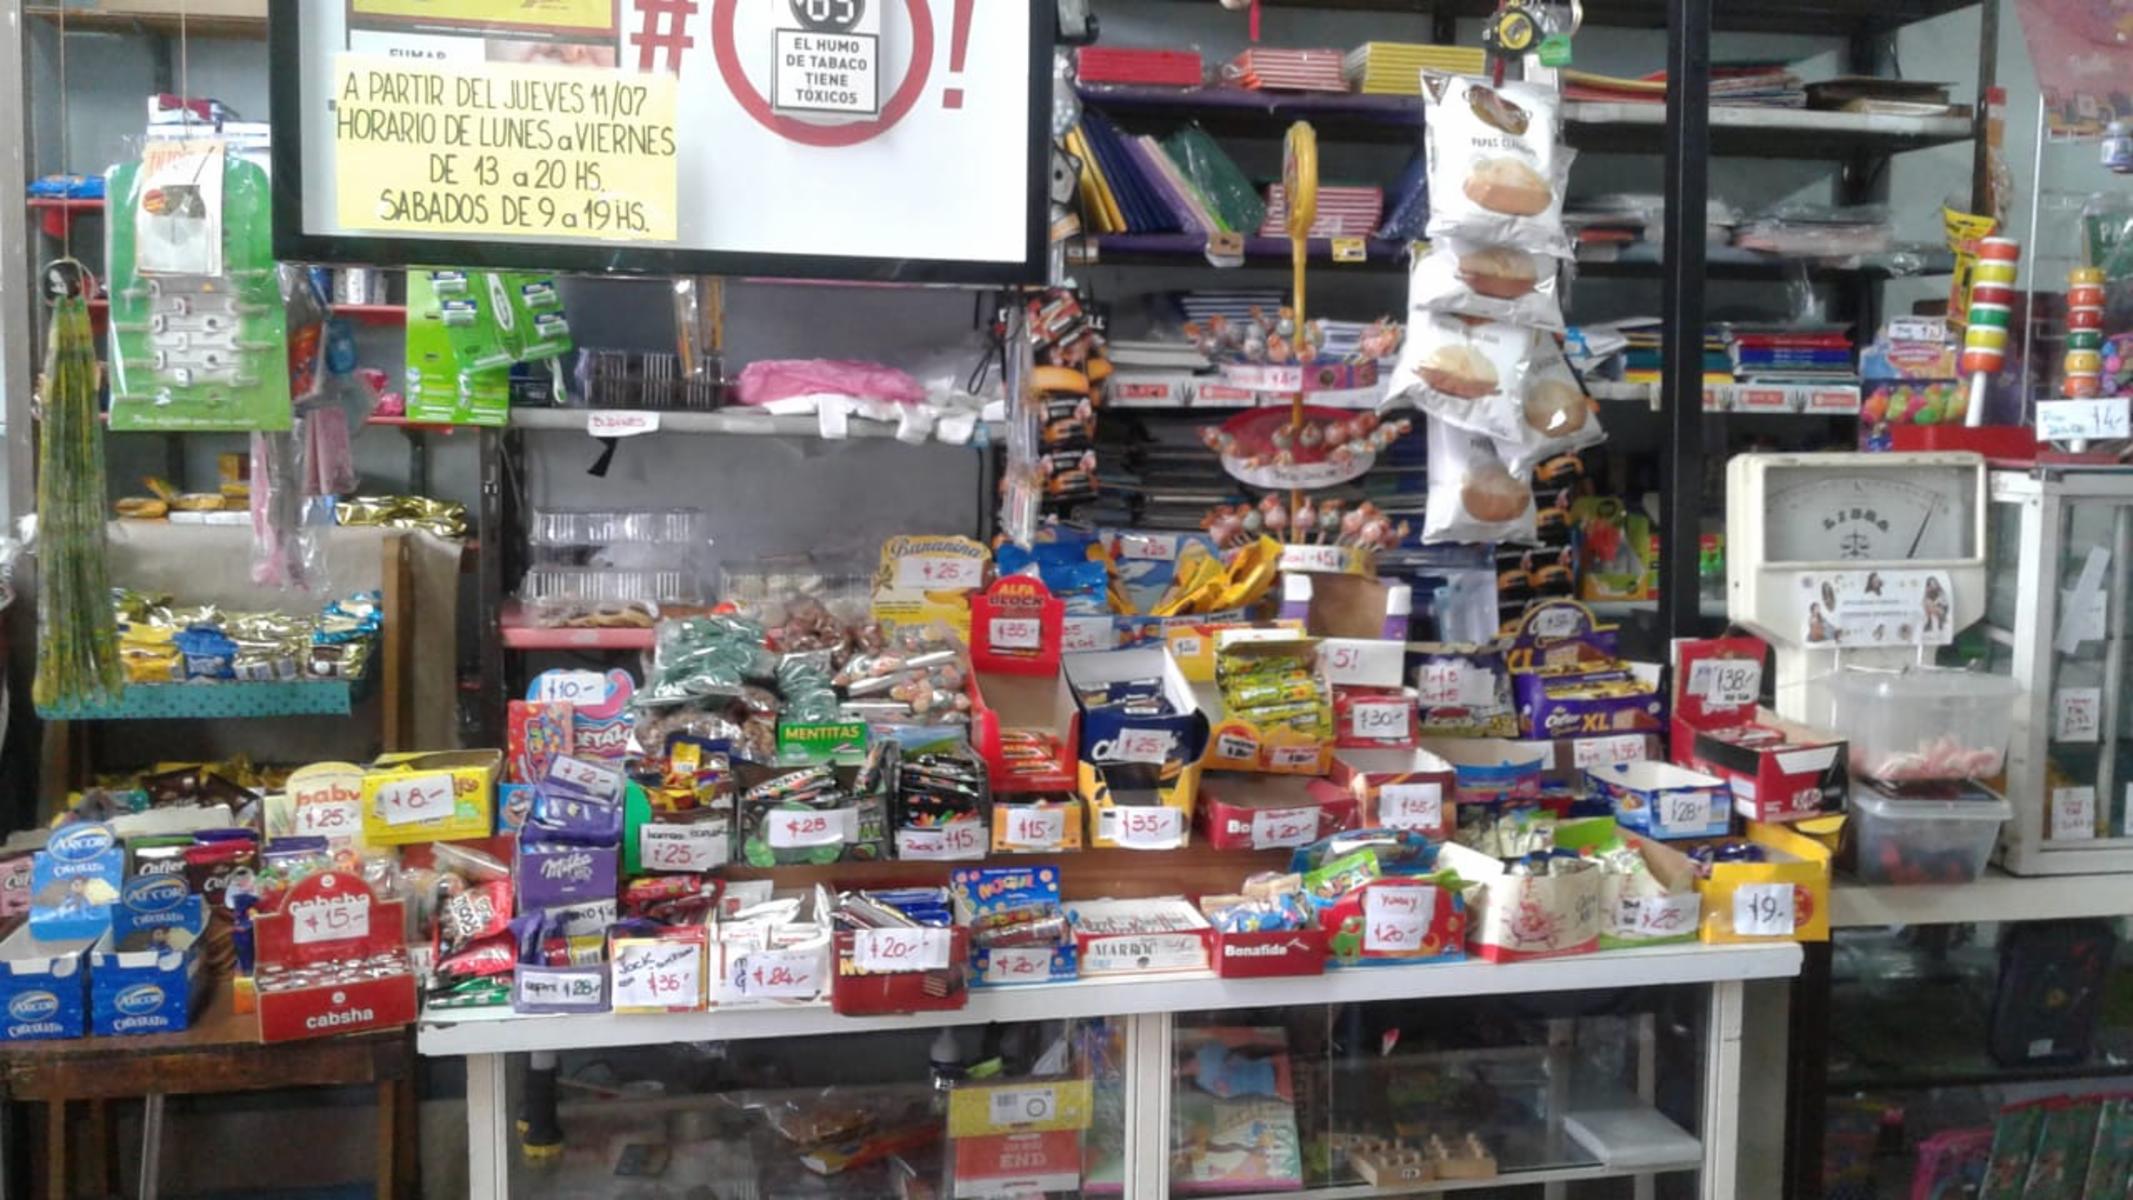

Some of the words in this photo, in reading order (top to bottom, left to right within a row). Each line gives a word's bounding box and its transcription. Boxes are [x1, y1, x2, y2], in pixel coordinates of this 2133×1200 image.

[794, 37, 812, 51] EL
[816, 39, 860, 54] HUMO
[786, 54, 806, 67] DE
[810, 55, 868, 71] TABACO
[805, 72, 849, 87] TIENE
[343, 72, 360, 101] A
[369, 72, 444, 106] PARTIR
[456, 77, 496, 109] DEL
[504, 79, 585, 114] JUEVES
[591, 84, 647, 120] 11/07
[337, 108, 436, 147] HORARIO
[445, 113, 471, 147] DE
[479, 116, 554, 152] LUNES
[575, 122, 676, 156] VIERNES
[430, 153, 459, 185] DE
[474, 155, 500, 187] 13
[534, 159, 567, 190] 20
[380, 188, 489, 225] SABADOS
[502, 195, 532, 228] DE
[537, 198, 556, 228] 9
[584, 201, 611, 231] 19
[1823, 507, 1889, 533] LIBRA
[784, 725, 861, 741] MENTITAS
[1581, 711, 1609, 733] XL
[1224, 942, 1289, 958] Bonafide
[305, 1006, 375, 1030] cabsha
